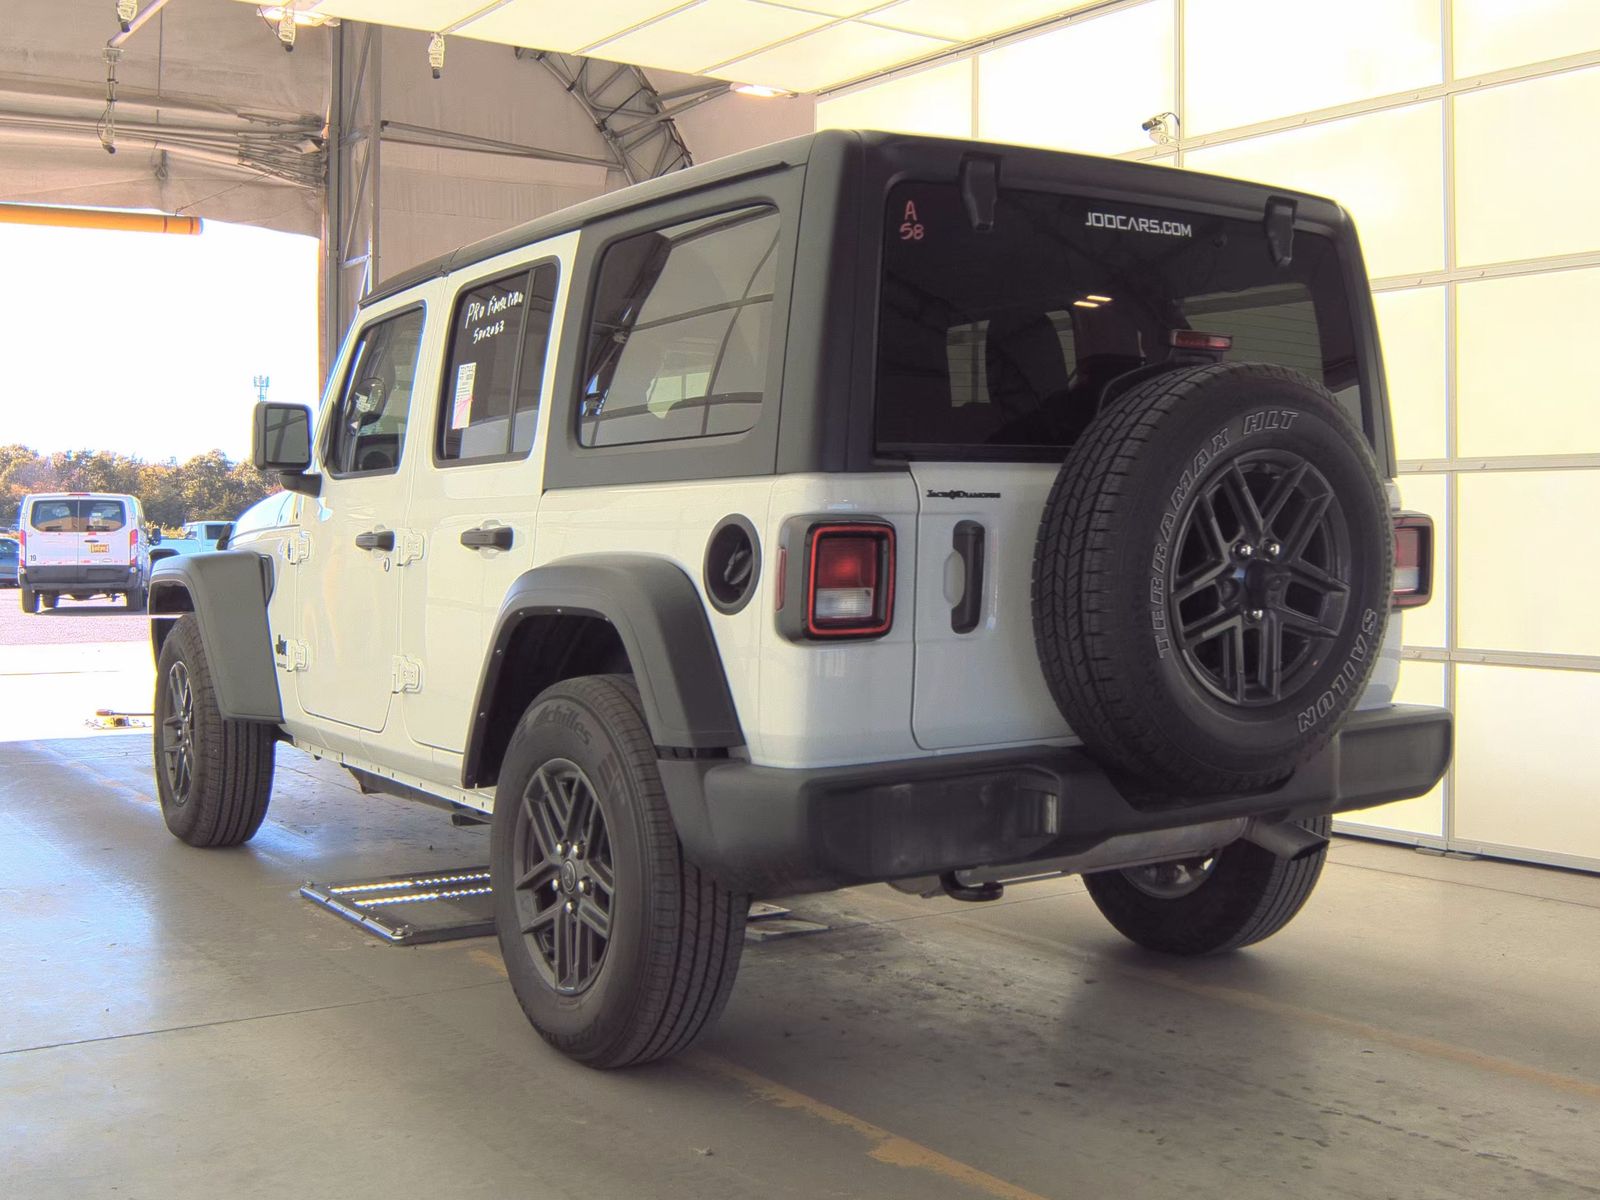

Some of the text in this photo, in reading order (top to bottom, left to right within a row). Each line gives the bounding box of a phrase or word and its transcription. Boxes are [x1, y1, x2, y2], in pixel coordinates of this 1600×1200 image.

[904, 199, 918, 221] A
[899, 222, 925, 240] 58
[1149, 409, 1299, 659] TERRAMAX HLT
[30, 554, 37, 562] 19
[1297, 608, 1377, 733] SAILUN
[534, 705, 593, 746] Achilles
